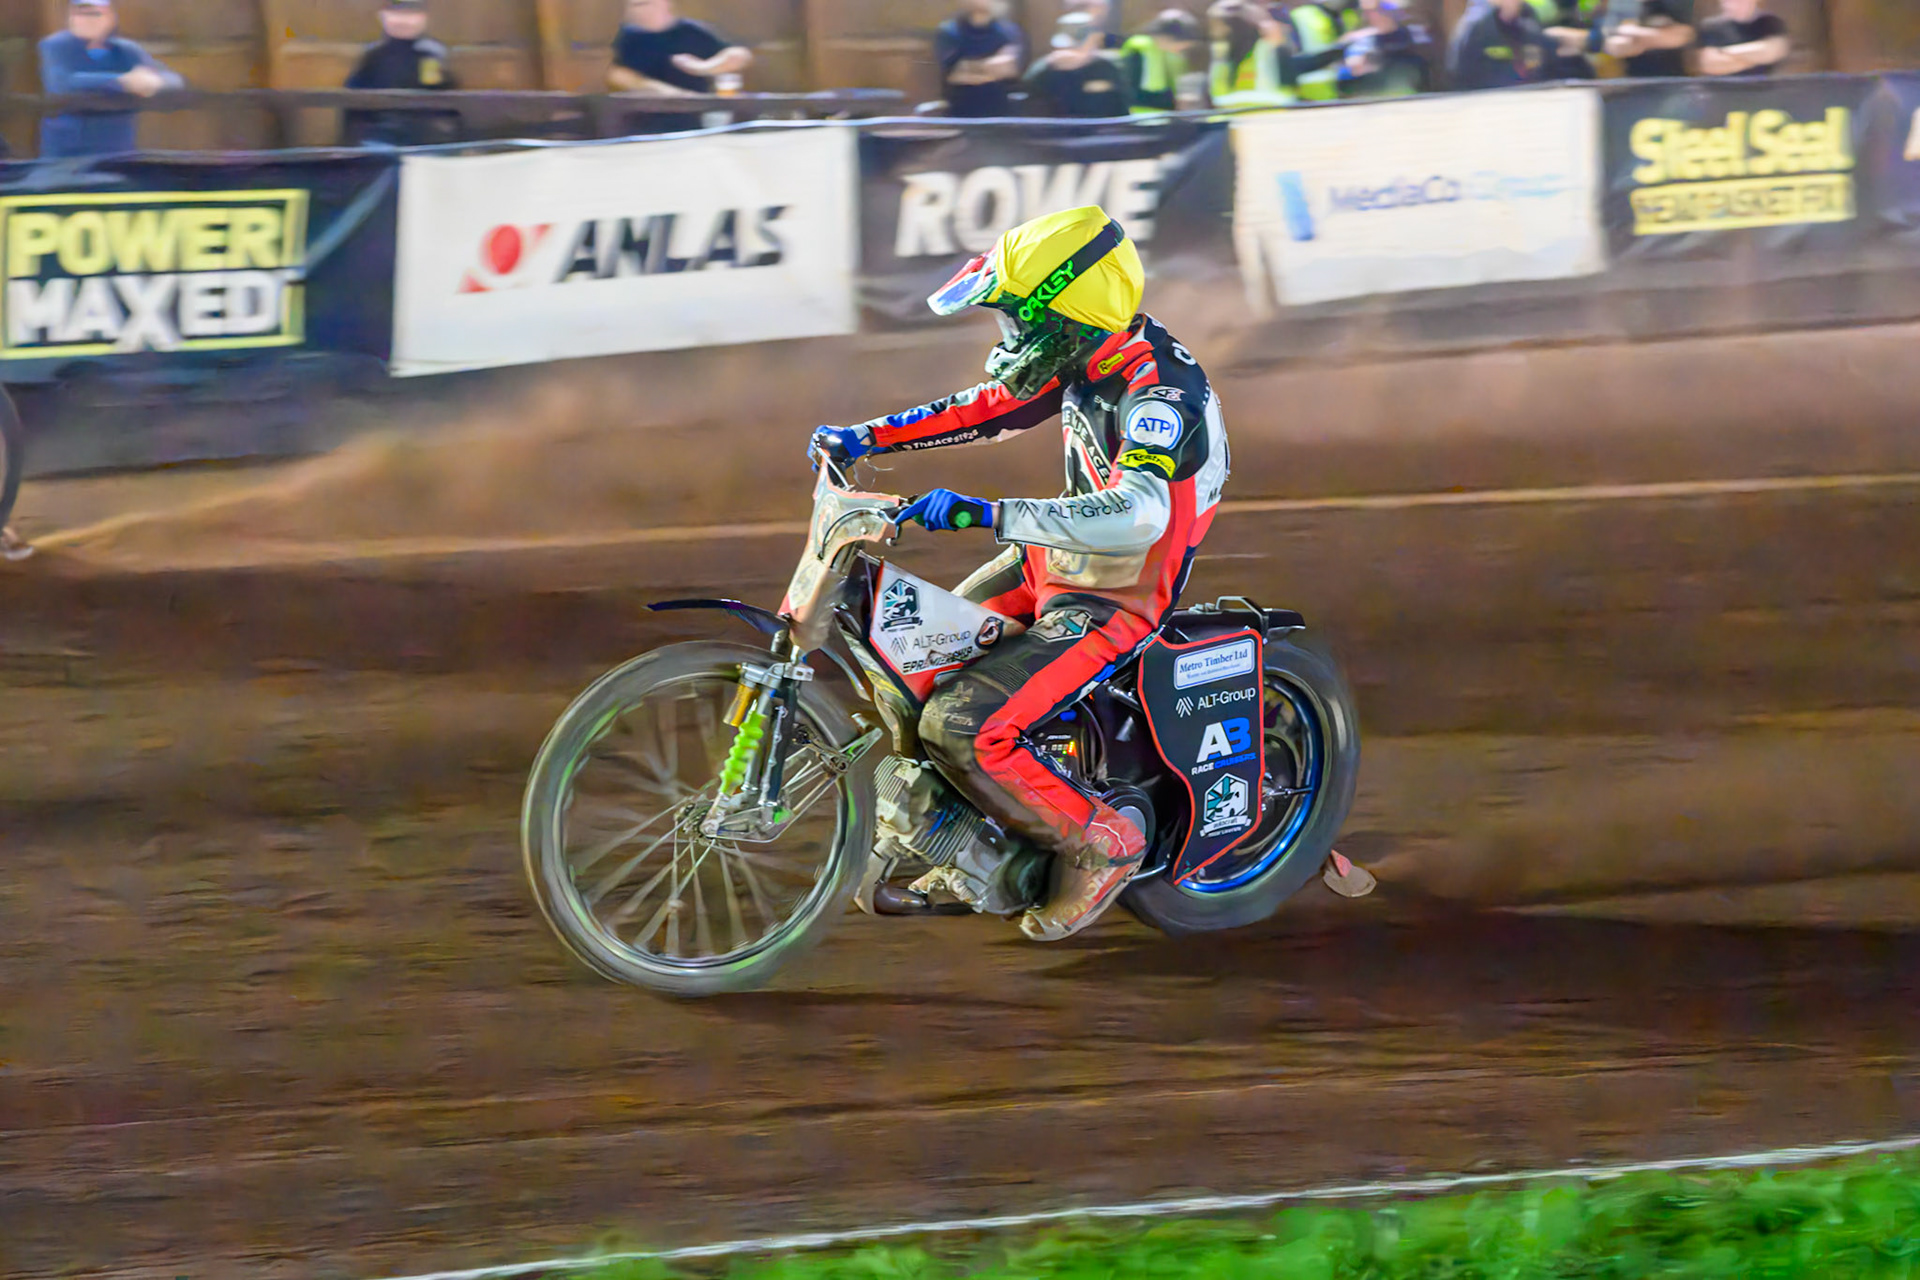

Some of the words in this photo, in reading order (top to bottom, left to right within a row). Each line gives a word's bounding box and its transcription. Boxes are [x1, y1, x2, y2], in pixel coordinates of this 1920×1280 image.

[895, 158, 1162, 257] ROWE
[7, 206, 283, 277] POWER
[1018, 259, 1076, 321] OAKLEY
[6, 270, 284, 352] MAXED
[1134, 417, 1175, 438] ATPI
[1047, 499, 1133, 520] ALT-Group
[912, 631, 971, 650] ALT-Group
[1180, 662, 1204, 674] Metro
[1204, 652, 1234, 667] Timber
[1234, 648, 1248, 660] Ltd
[1197, 688, 1256, 711] ALT-Group
[1196, 717, 1252, 763] AB
[1191, 762, 1214, 776] RACE
